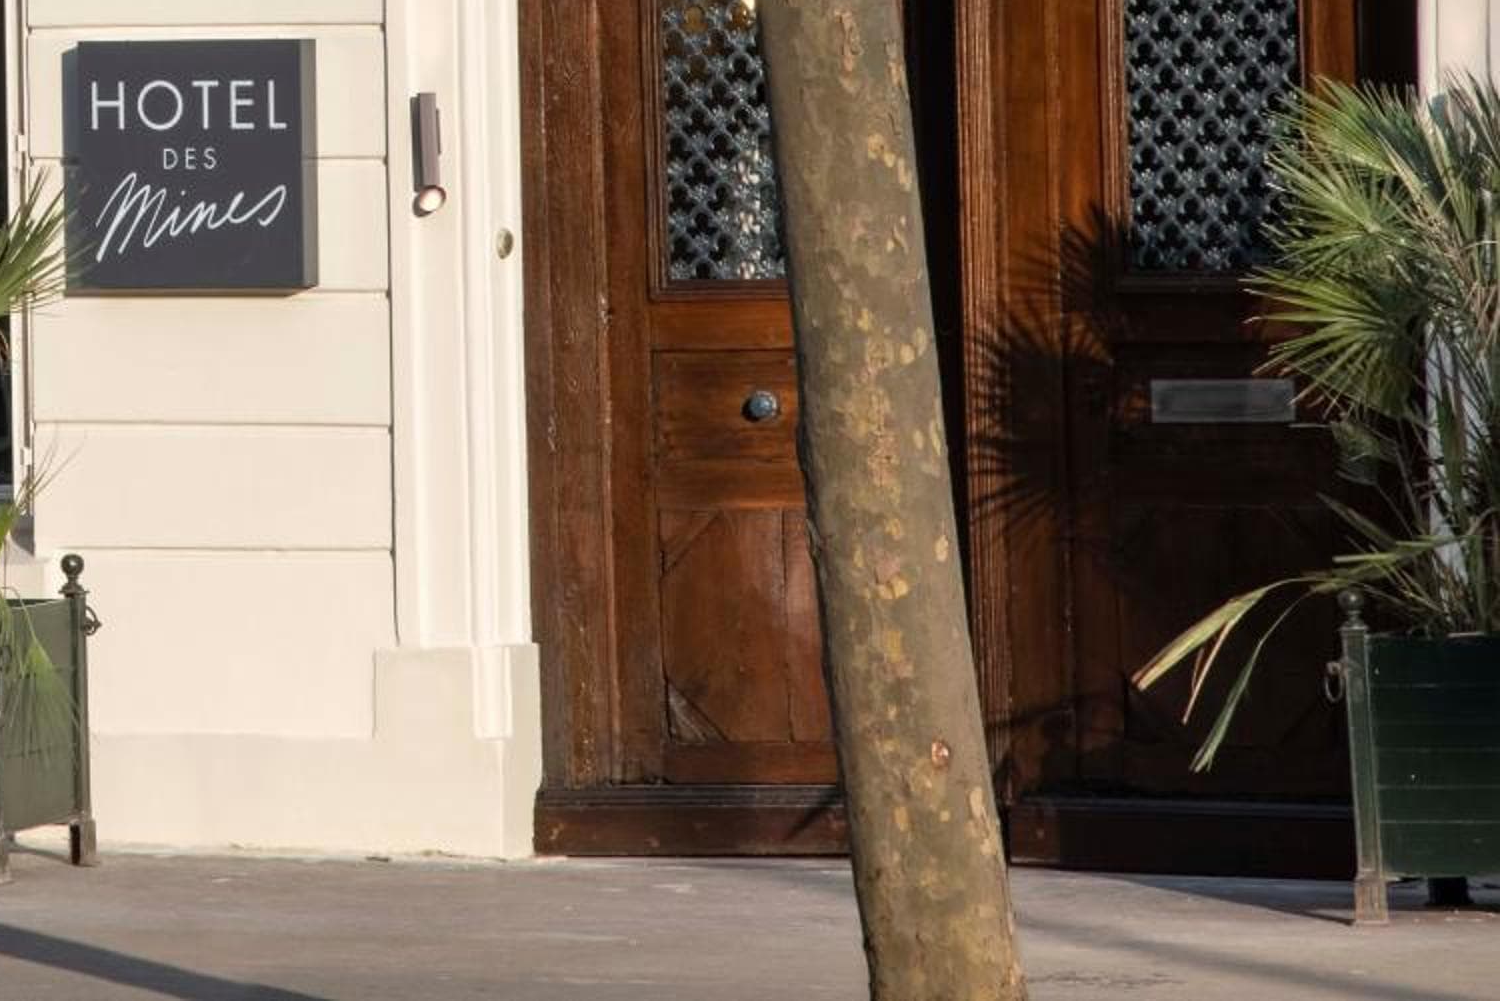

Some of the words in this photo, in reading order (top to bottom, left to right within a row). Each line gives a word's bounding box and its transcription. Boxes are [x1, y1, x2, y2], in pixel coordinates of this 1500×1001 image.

[91, 80, 288, 130] HOTEL
[163, 148, 218, 170] DES
[95, 171, 287, 263] Mines
